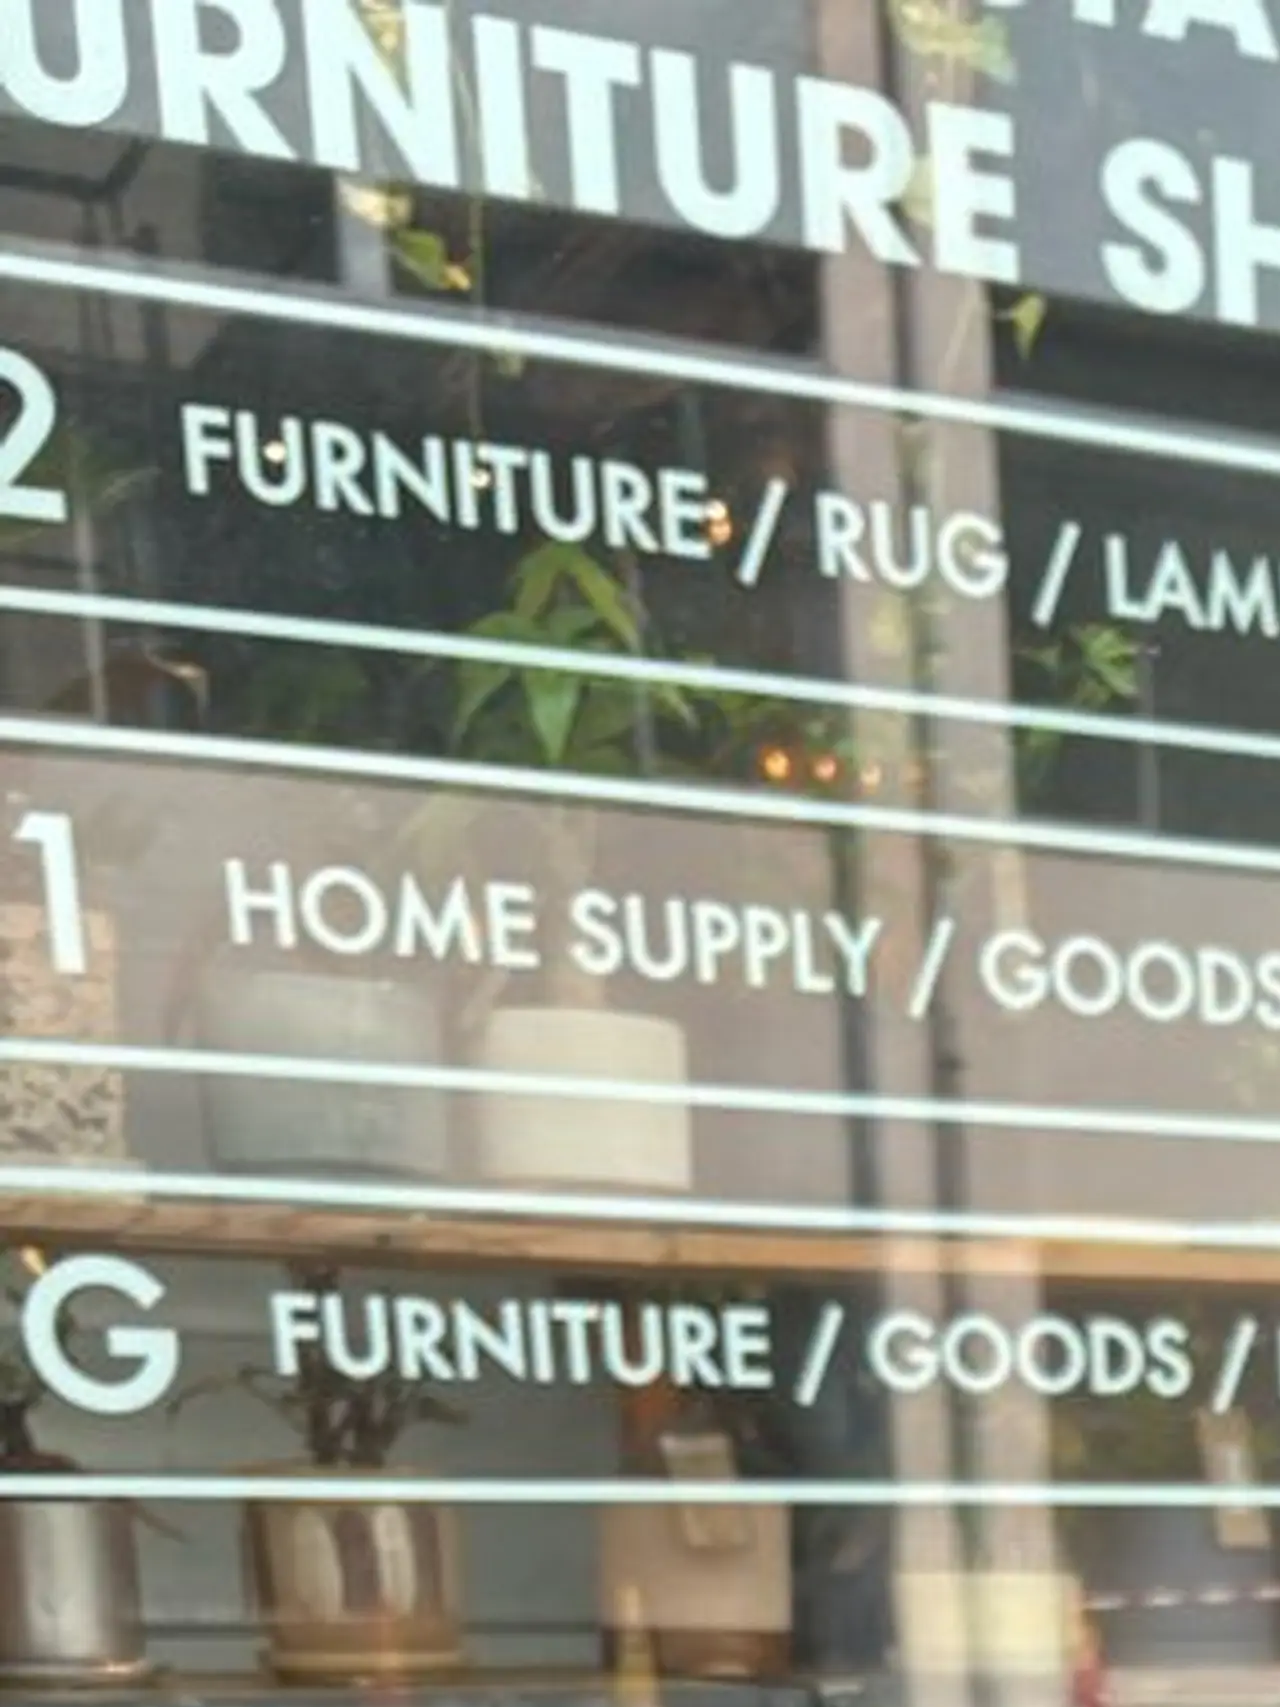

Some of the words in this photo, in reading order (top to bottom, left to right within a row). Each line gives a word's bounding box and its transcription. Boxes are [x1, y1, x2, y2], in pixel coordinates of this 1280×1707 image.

[0, 348, 66, 521] 2
[180, 402, 713, 561] FURNITURE
[818, 494, 1006, 599] RUG
[15, 811, 85, 974] 1
[225, 858, 539, 968] HOME
[569, 889, 882, 995] SUPPLY
[21, 1255, 178, 1413] G
[270, 1292, 771, 1387] FURNITURE
[872, 1311, 1190, 1395] GOODS
